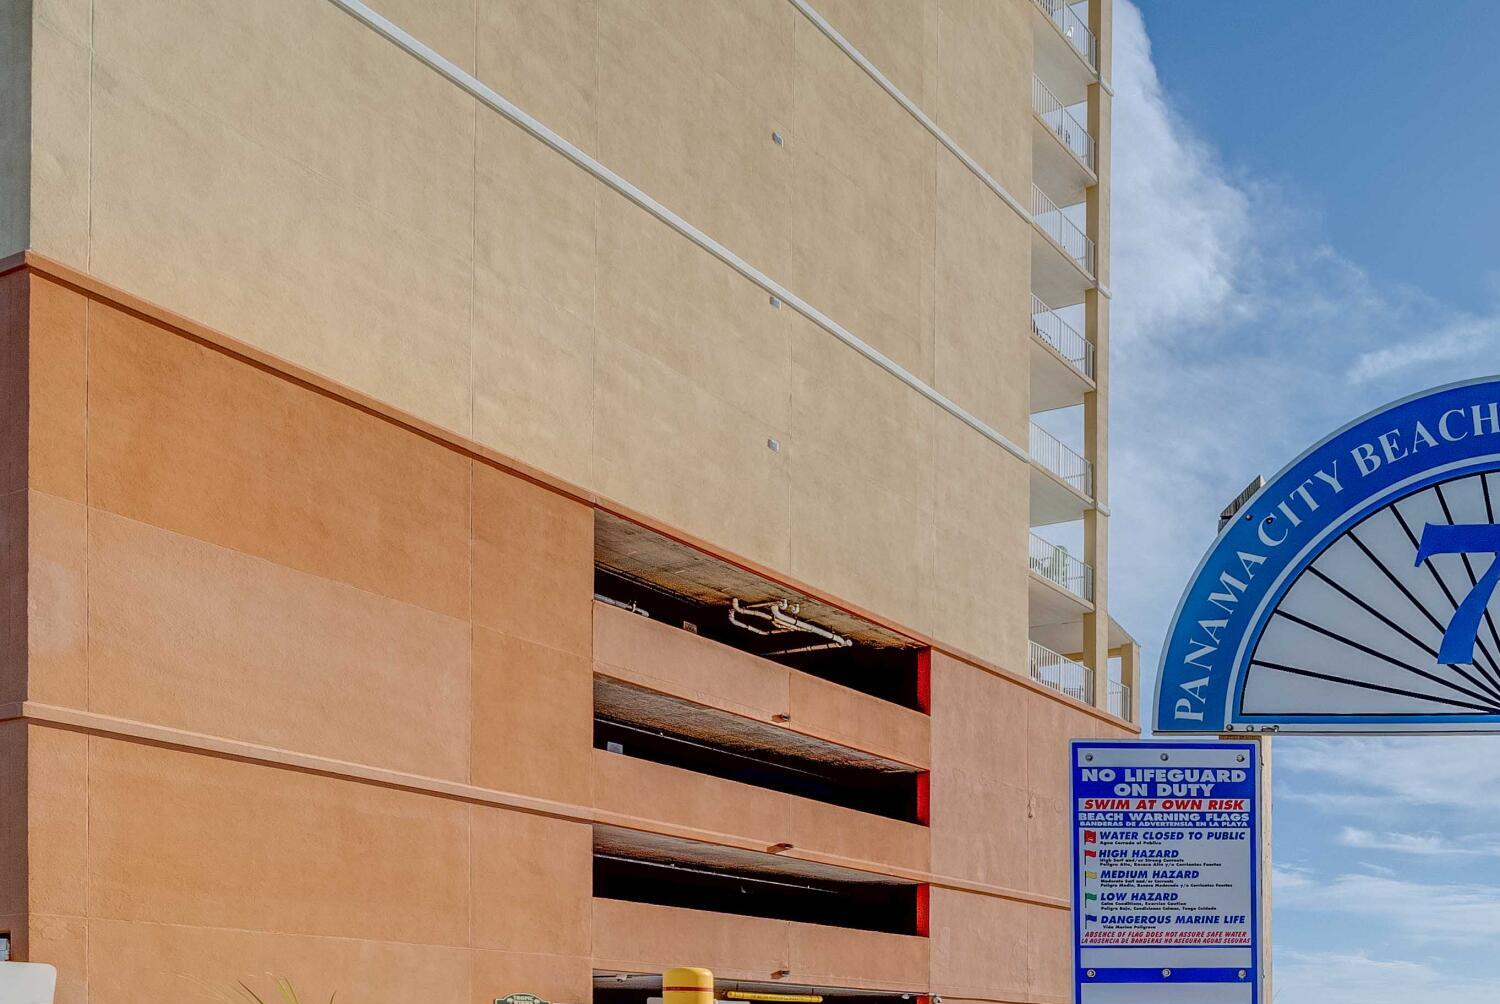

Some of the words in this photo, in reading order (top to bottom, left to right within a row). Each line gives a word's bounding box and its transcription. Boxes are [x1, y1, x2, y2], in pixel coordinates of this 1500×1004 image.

[1174, 551, 1268, 721] PANAMA
[1257, 460, 1344, 547] CITY
[1349, 402, 1500, 477] BEACH
[1082, 769, 1115, 782] NO
[1124, 769, 1246, 782] LIFEGUARD
[1114, 784, 1147, 796] ON
[1156, 784, 1215, 797] DUTY
[1084, 800, 1130, 809] SWIM
[1136, 800, 1156, 809] AT
[1161, 800, 1202, 809] OWN
[1208, 800, 1243, 809] RISK
[1078, 813, 1123, 821] BEACH
[1129, 813, 1200, 821] WARNING
[1205, 813, 1249, 821] FLAGS
[1100, 832, 1138, 840] WATER
[1142, 832, 1184, 840] CLOSED
[1188, 832, 1202, 840] TO
[1206, 832, 1245, 840] PUBLIC
[1099, 850, 1127, 858] HIGH
[1131, 850, 1179, 858] HAZARD
[1130, 893, 1178, 901] HAZARD
[1175, 916, 1219, 924] MARINE
[1223, 916, 1245, 924] LIFE
